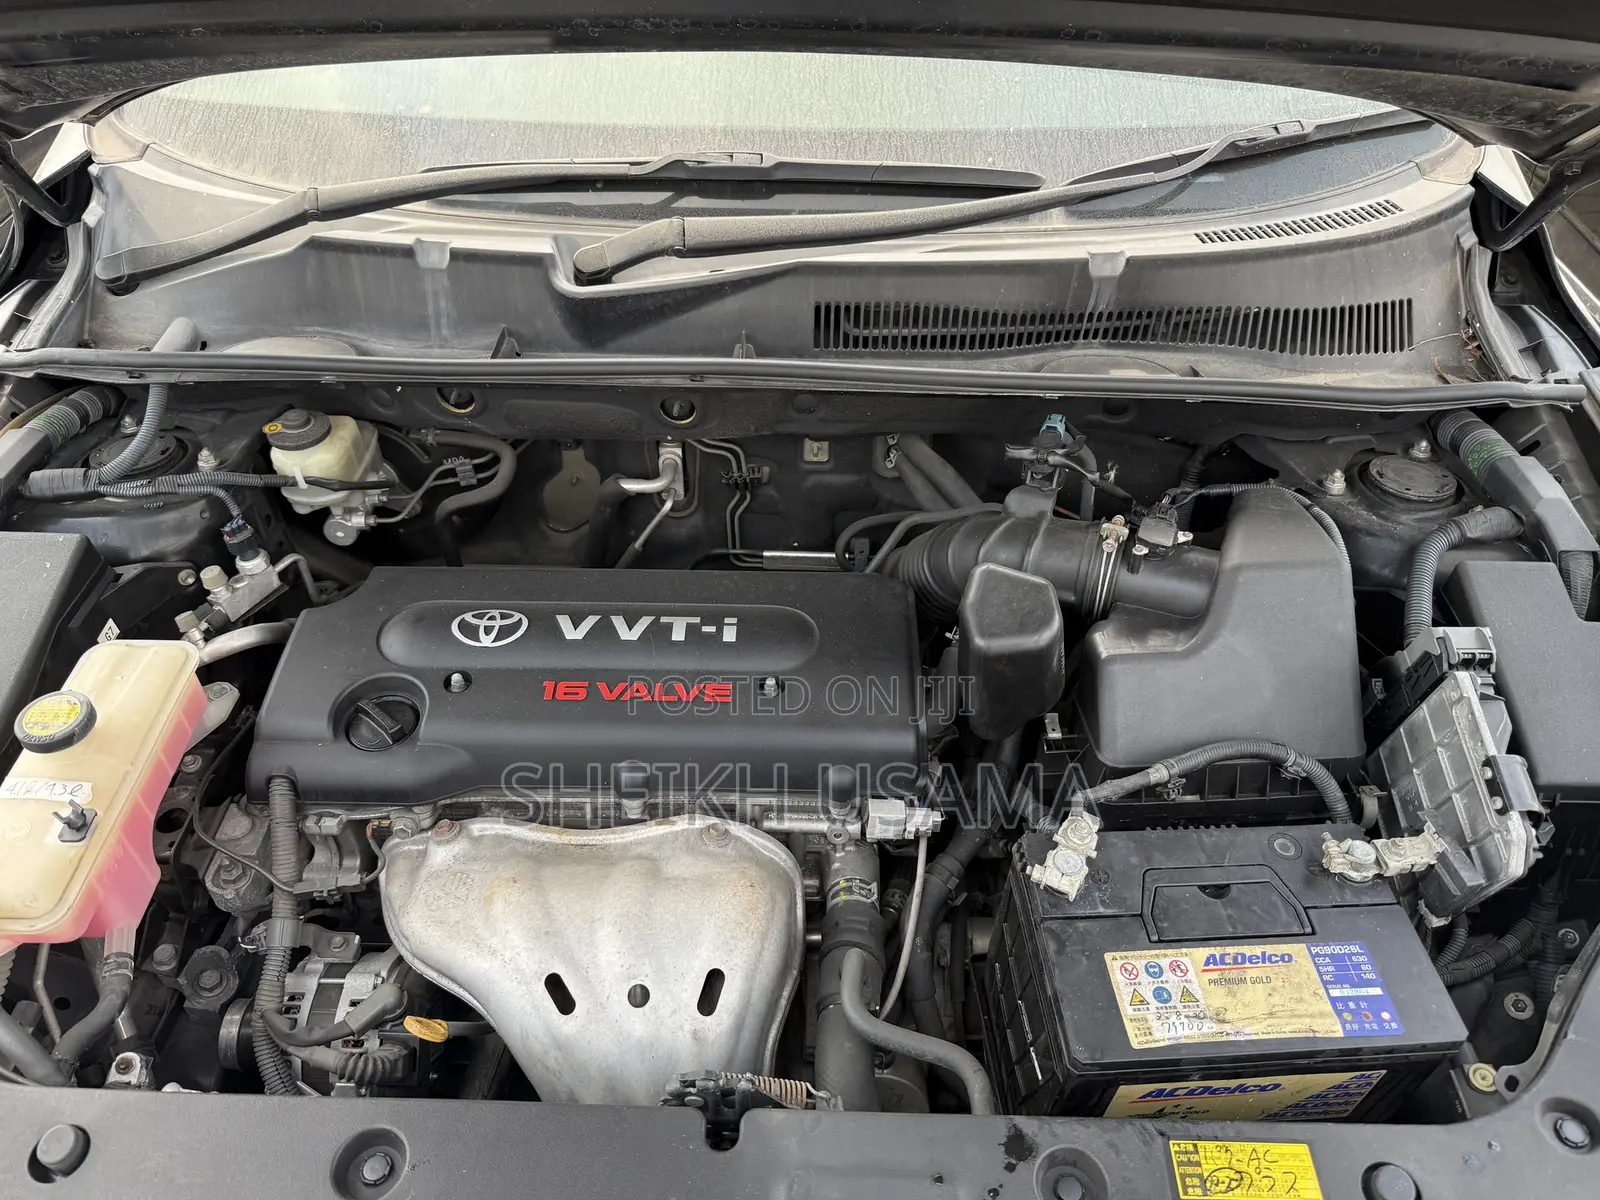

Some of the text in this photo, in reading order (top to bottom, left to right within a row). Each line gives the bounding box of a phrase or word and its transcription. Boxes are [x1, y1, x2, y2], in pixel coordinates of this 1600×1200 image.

[555, 615, 737, 642] VVT-i
[542, 681, 734, 702] 16 VALVE
[1203, 951, 1293, 967] ACDelco
[1208, 976, 1272, 986] PREMIUM GOLD
[1137, 1083, 1282, 1099] ACDelco
